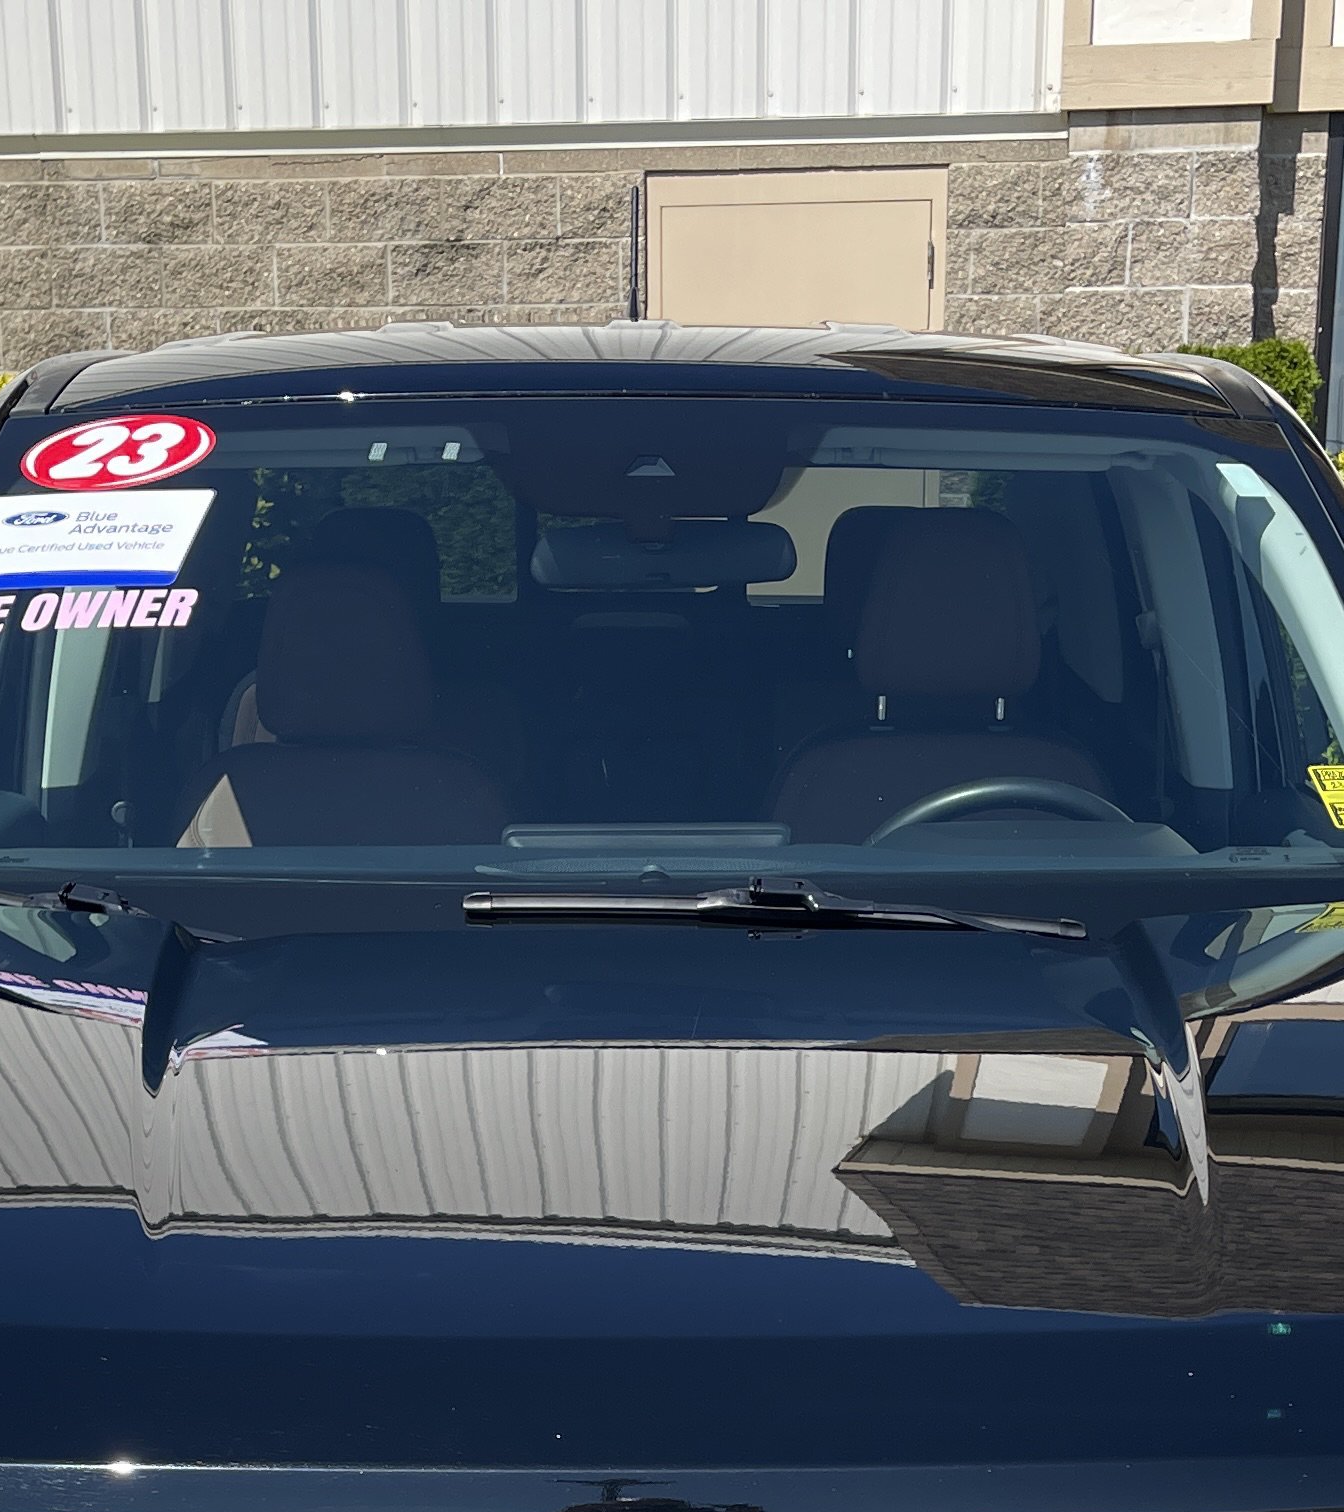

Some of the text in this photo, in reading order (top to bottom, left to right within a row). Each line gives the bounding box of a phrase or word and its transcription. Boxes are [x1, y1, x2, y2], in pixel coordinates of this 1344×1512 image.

[49, 422, 186, 480] 23
[75, 511, 118, 522] Blue
[67, 523, 174, 535] Advantage
[18, 542, 75, 554] Certified
[78, 541, 112, 551] Used
[116, 541, 165, 551] Vehicle
[20, 588, 199, 632] OWNER
